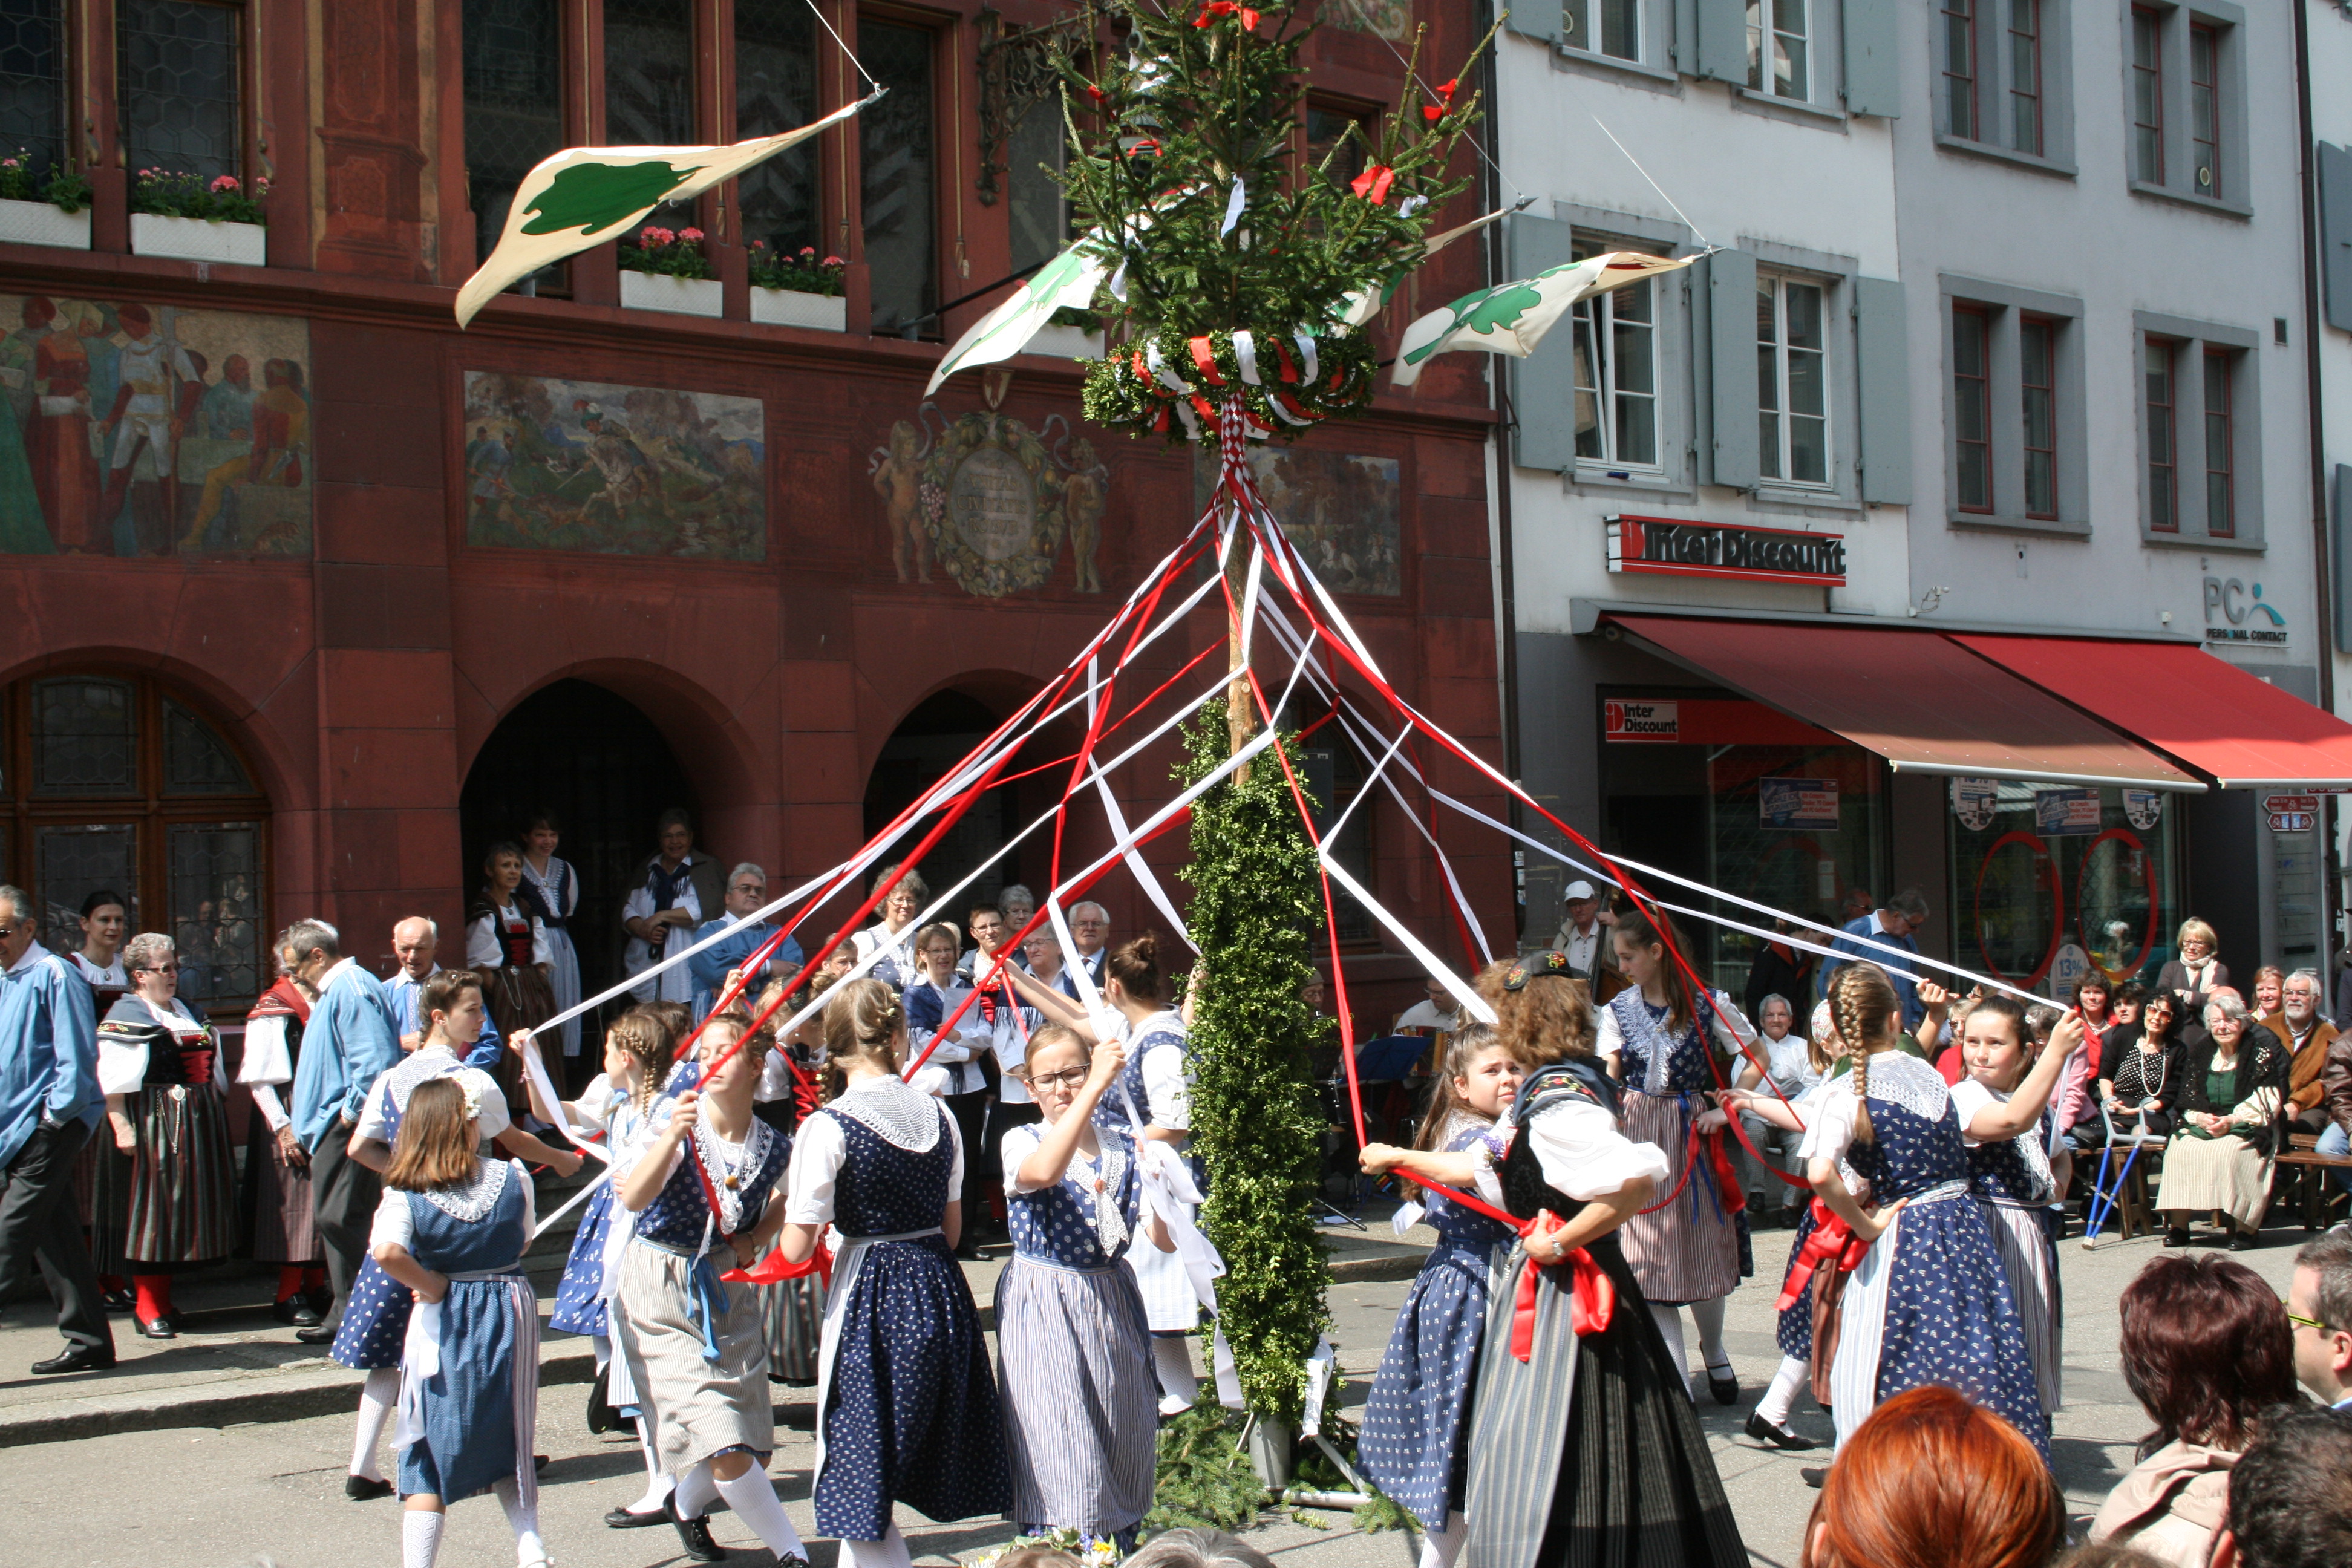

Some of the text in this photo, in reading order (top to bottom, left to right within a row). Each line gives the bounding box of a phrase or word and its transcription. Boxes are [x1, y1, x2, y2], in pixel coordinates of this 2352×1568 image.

[957, 495, 1028, 515] CIVITATIS
[2203, 577, 2246, 624] PC
[2251, 630, 2287, 642] CONTACT
[1624, 704, 1654, 718] Inter
[1624, 718, 1677, 733] Discount
